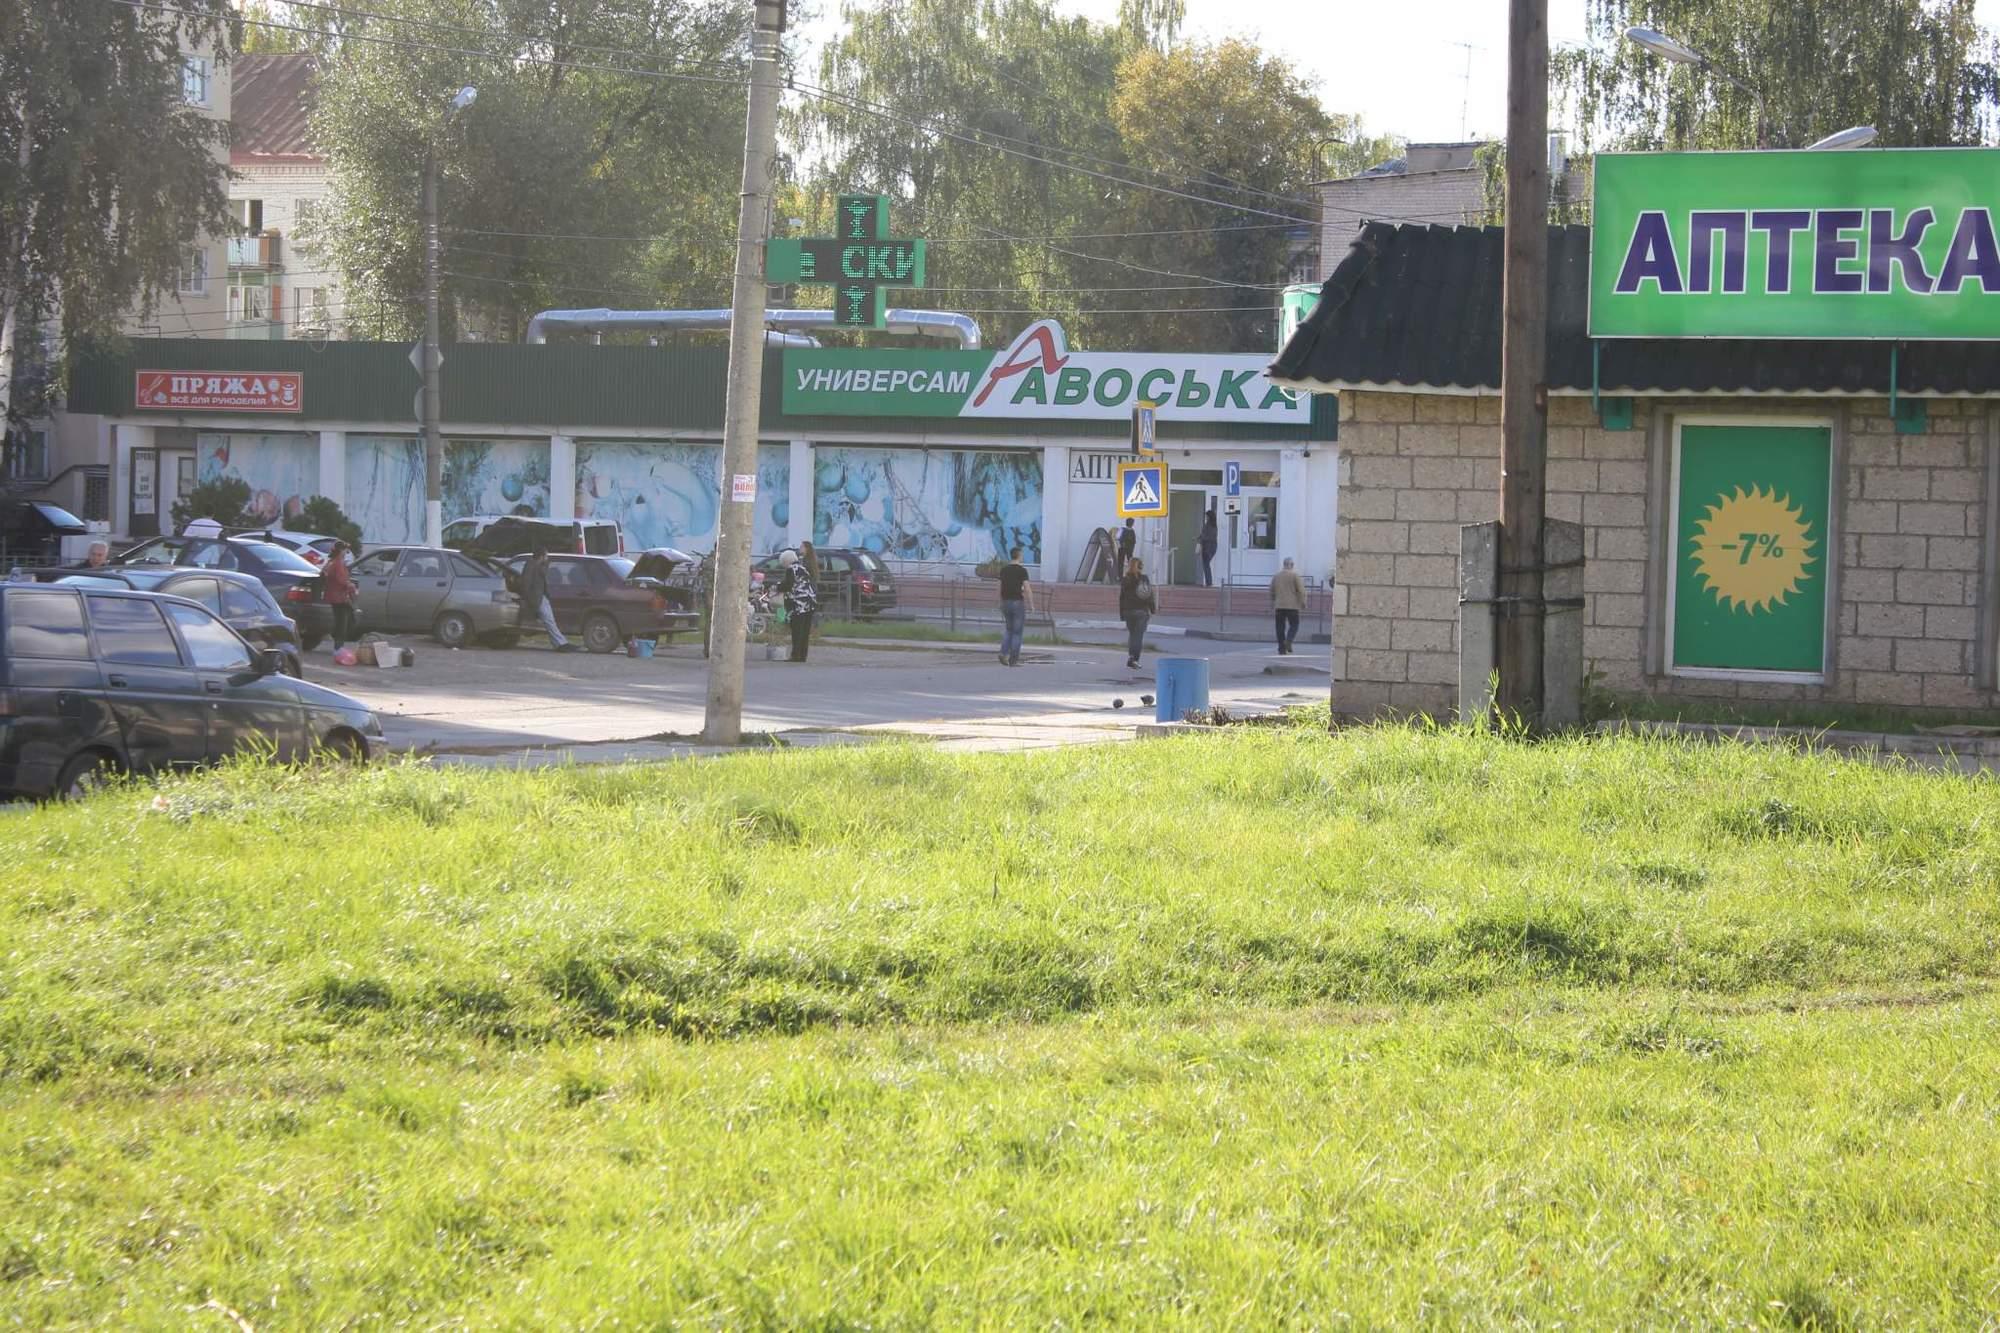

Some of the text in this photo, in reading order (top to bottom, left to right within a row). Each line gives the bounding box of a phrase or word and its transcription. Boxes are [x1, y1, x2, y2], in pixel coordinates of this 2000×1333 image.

[1612, 206, 2000, 296] АПТЕКА
[171, 376, 267, 395] ПРЯЖА
[796, 367, 971, 394] УНИВЕРСАМ
[191, 396, 210, 405] ДЛЯ
[212, 396, 267, 406] РУКОДЕЛИЯ
[1720, 532, 1784, 566] -7%
